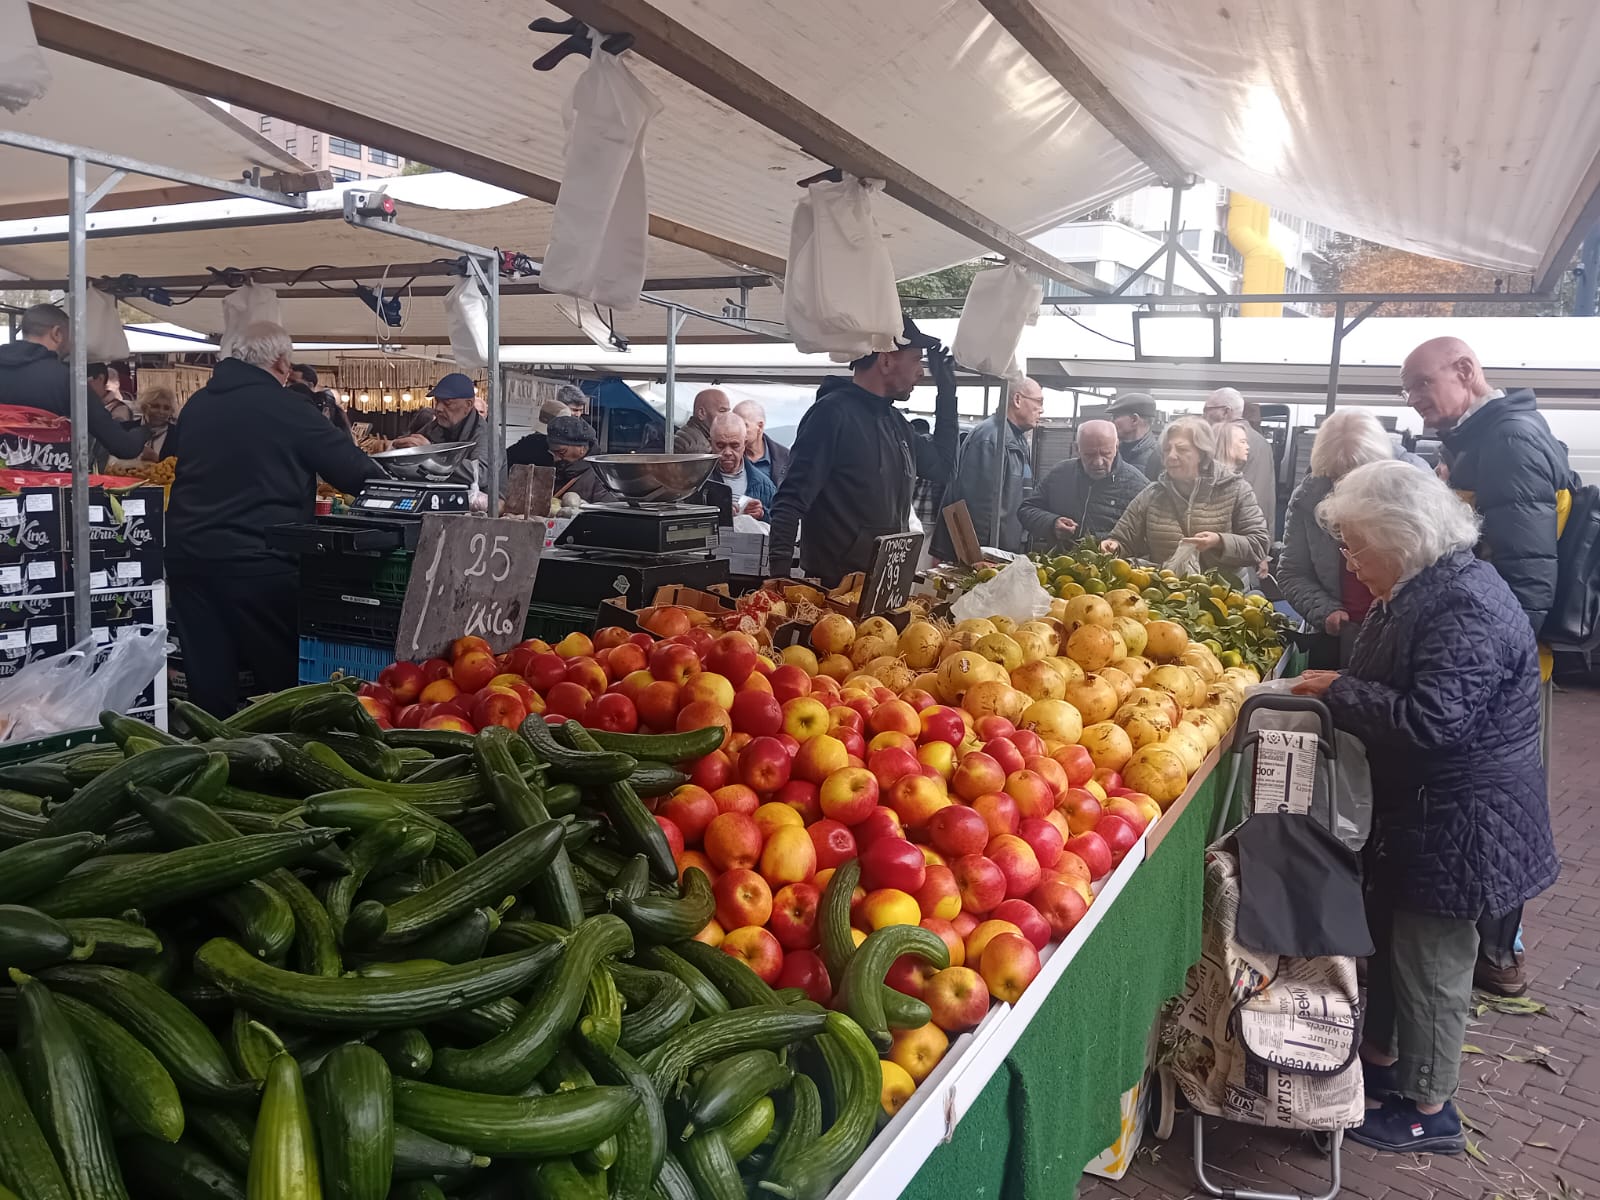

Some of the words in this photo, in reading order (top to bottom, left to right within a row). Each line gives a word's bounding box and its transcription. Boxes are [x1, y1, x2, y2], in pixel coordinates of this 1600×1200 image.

[31, 443, 73, 471] King
[16, 519, 49, 549] King
[123, 518, 153, 546] King
